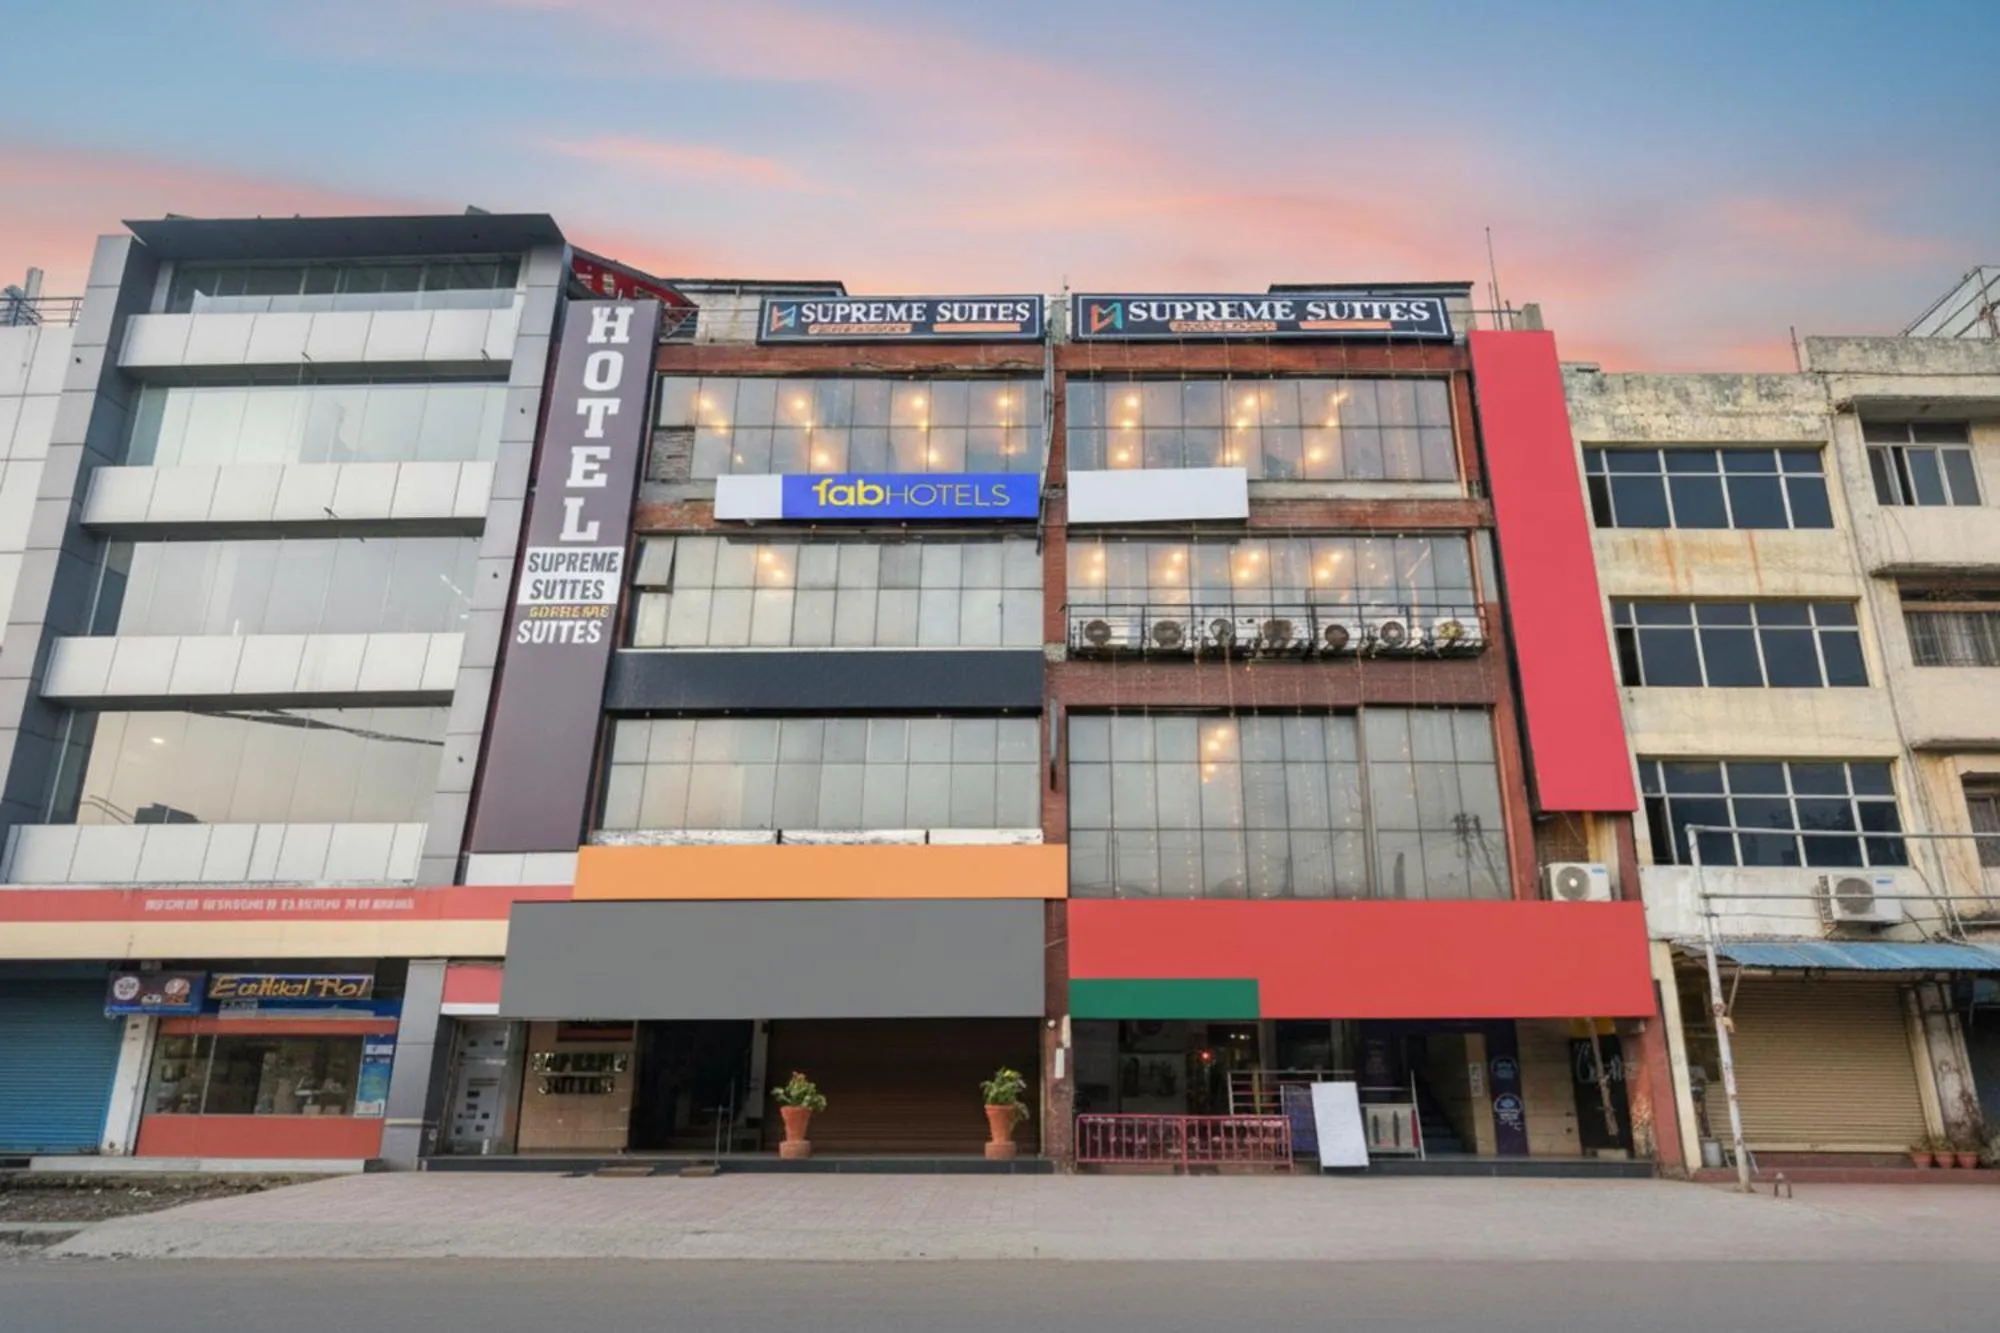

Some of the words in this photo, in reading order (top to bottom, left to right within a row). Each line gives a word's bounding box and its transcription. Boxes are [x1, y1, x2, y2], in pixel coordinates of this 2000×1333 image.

[801, 302, 926, 323] SUPREME
[936, 302, 1030, 322] SUITES
[1128, 300, 1296, 322] SUPREME
[1305, 301, 1430, 322] SUITES
[559, 306, 634, 541] HOTEL
[527, 552, 619, 573] SUPREME
[529, 578, 605, 600] SUITES
[516, 620, 603, 644] SUITES
